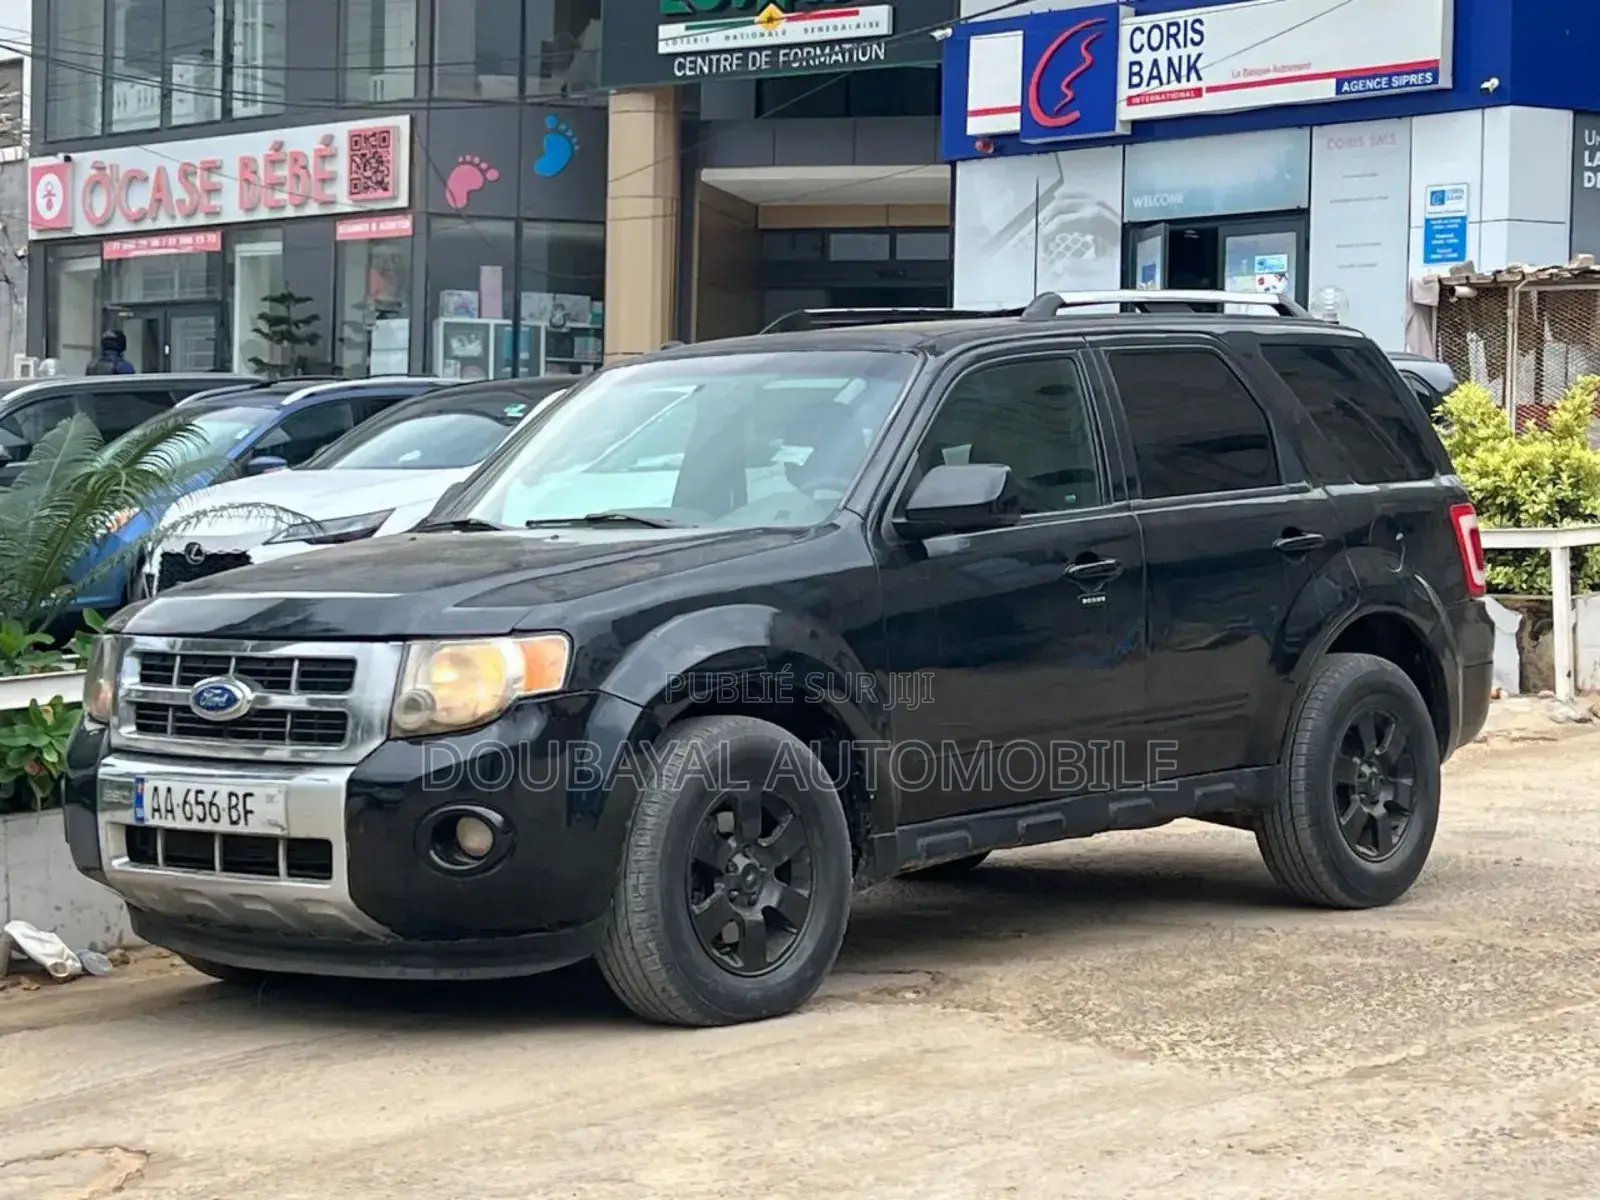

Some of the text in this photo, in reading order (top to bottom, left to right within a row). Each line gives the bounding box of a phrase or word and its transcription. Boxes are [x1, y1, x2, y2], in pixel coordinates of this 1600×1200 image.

[1129, 18, 1205, 54] CORIS
[673, 41, 886, 76] CENTRE DE FORMATION
[1128, 52, 1203, 89] BANK
[1341, 72, 1434, 93] AGENCE SIPRES
[1131, 90, 1196, 104] INTERNATIONAL
[238, 133, 338, 211] BÉBÉ
[1132, 193, 1184, 209] WELCOME
[199, 689, 229, 707] Ford
